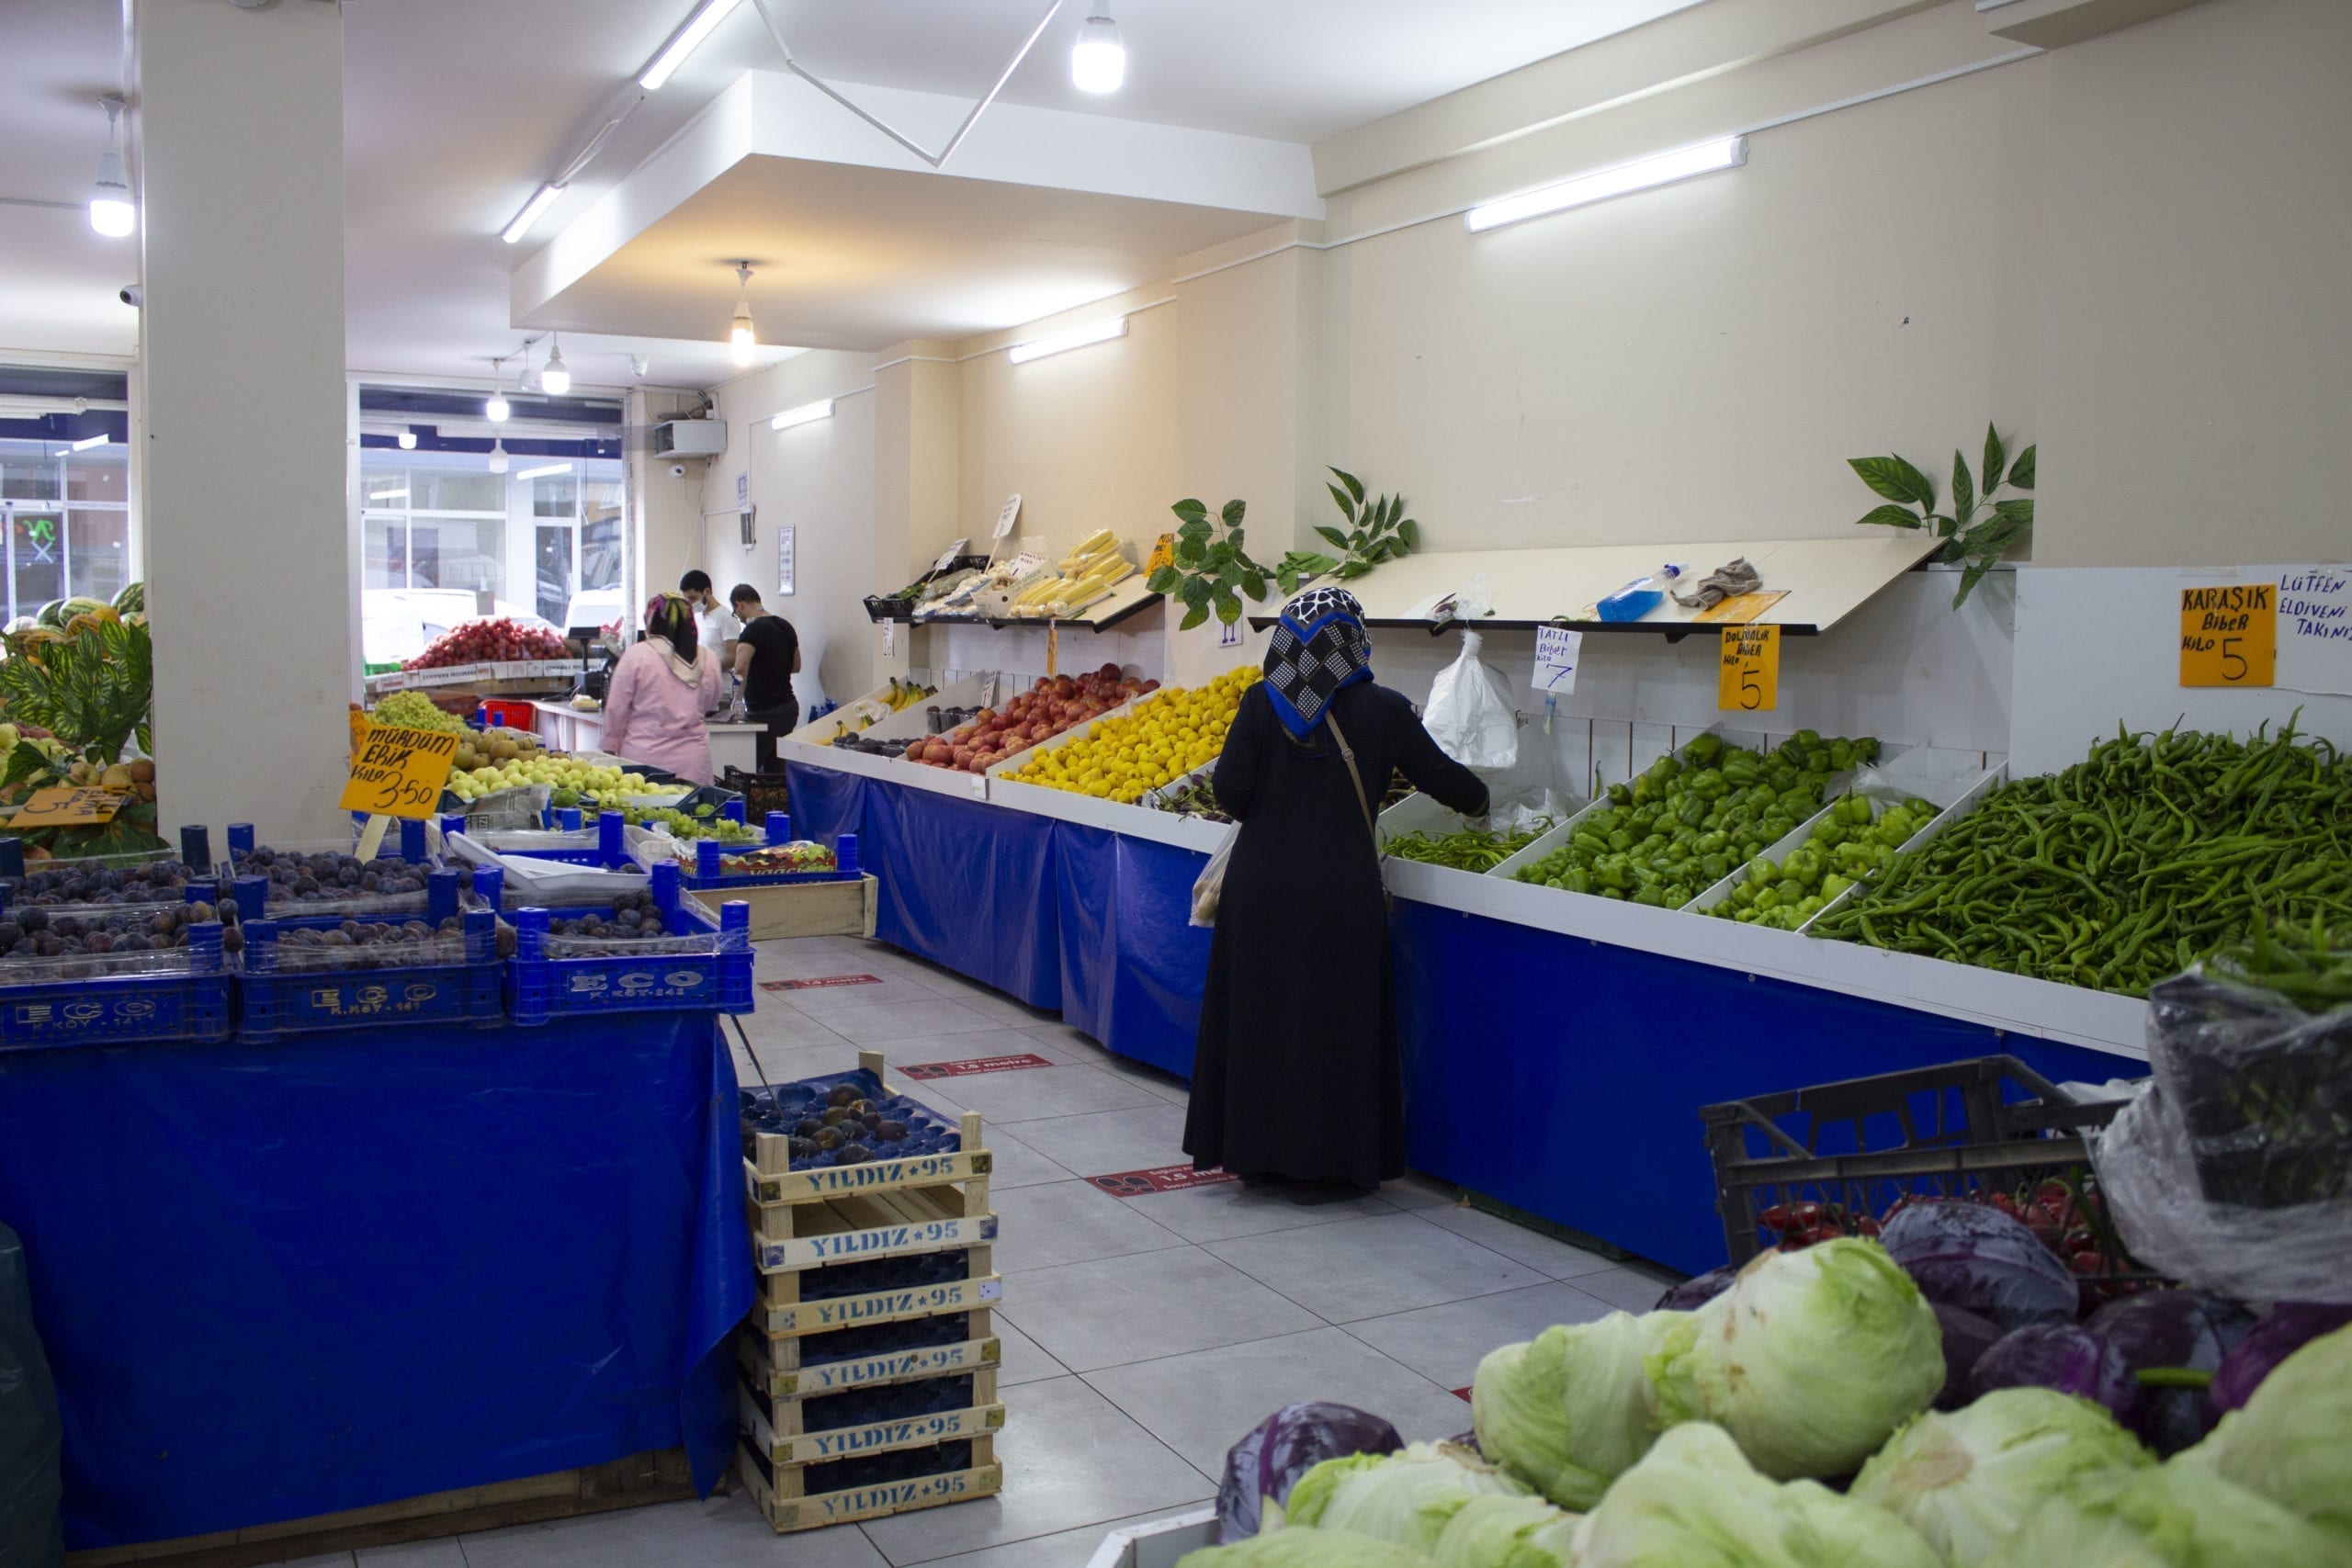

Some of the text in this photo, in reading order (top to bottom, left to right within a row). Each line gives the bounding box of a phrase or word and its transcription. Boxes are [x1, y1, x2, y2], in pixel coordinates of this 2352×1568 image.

[2182, 586, 2269, 613] KARAŞIK
[1545, 663, 1573, 688] 7
[2222, 637, 2247, 681] 5
[1740, 669, 1761, 710] 5
[571, 971, 704, 992] ECO
[983, 1057, 1032, 1068] metre
[806, 1157, 954, 1191] YILDIZ 95
[809, 1221, 959, 1258] YILDIZ 95
[817, 1287, 962, 1324] YILDIZ 95
[820, 1348, 964, 1386] YILDIZ 95
[814, 1415, 960, 1454] YILDIZ 95
[821, 1475, 966, 1515] YILDIZ 95
